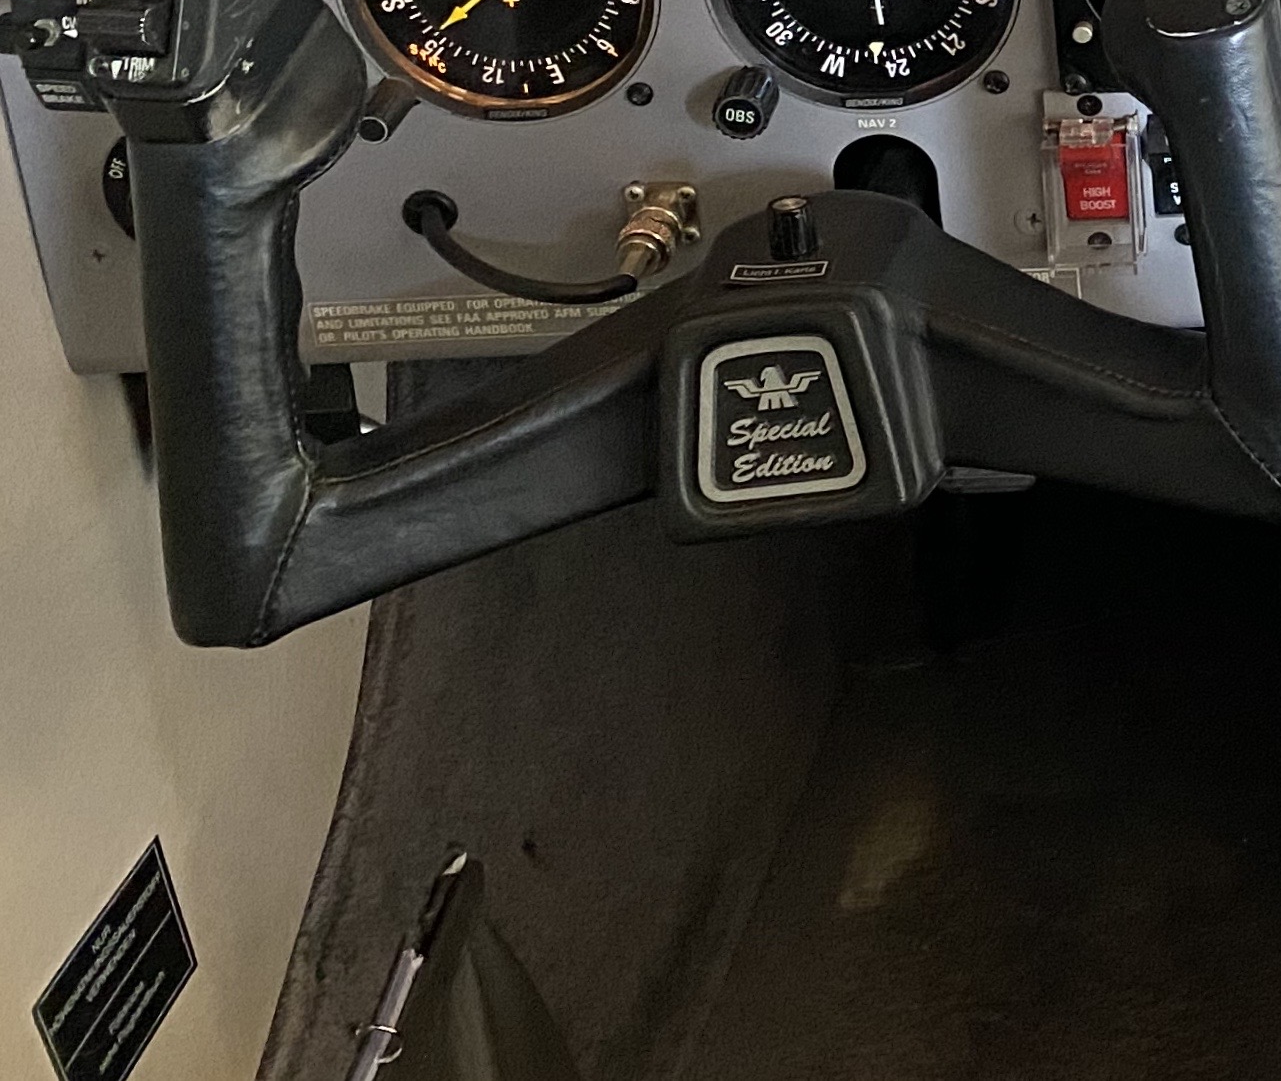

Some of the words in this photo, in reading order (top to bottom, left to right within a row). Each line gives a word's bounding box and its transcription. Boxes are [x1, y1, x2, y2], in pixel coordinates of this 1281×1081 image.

[726, 109, 754, 123] OBS
[857, 118, 886, 128] NAV
[889, 118, 896, 128] 2
[728, 413, 830, 450] Special
[733, 453, 833, 482] Edition
